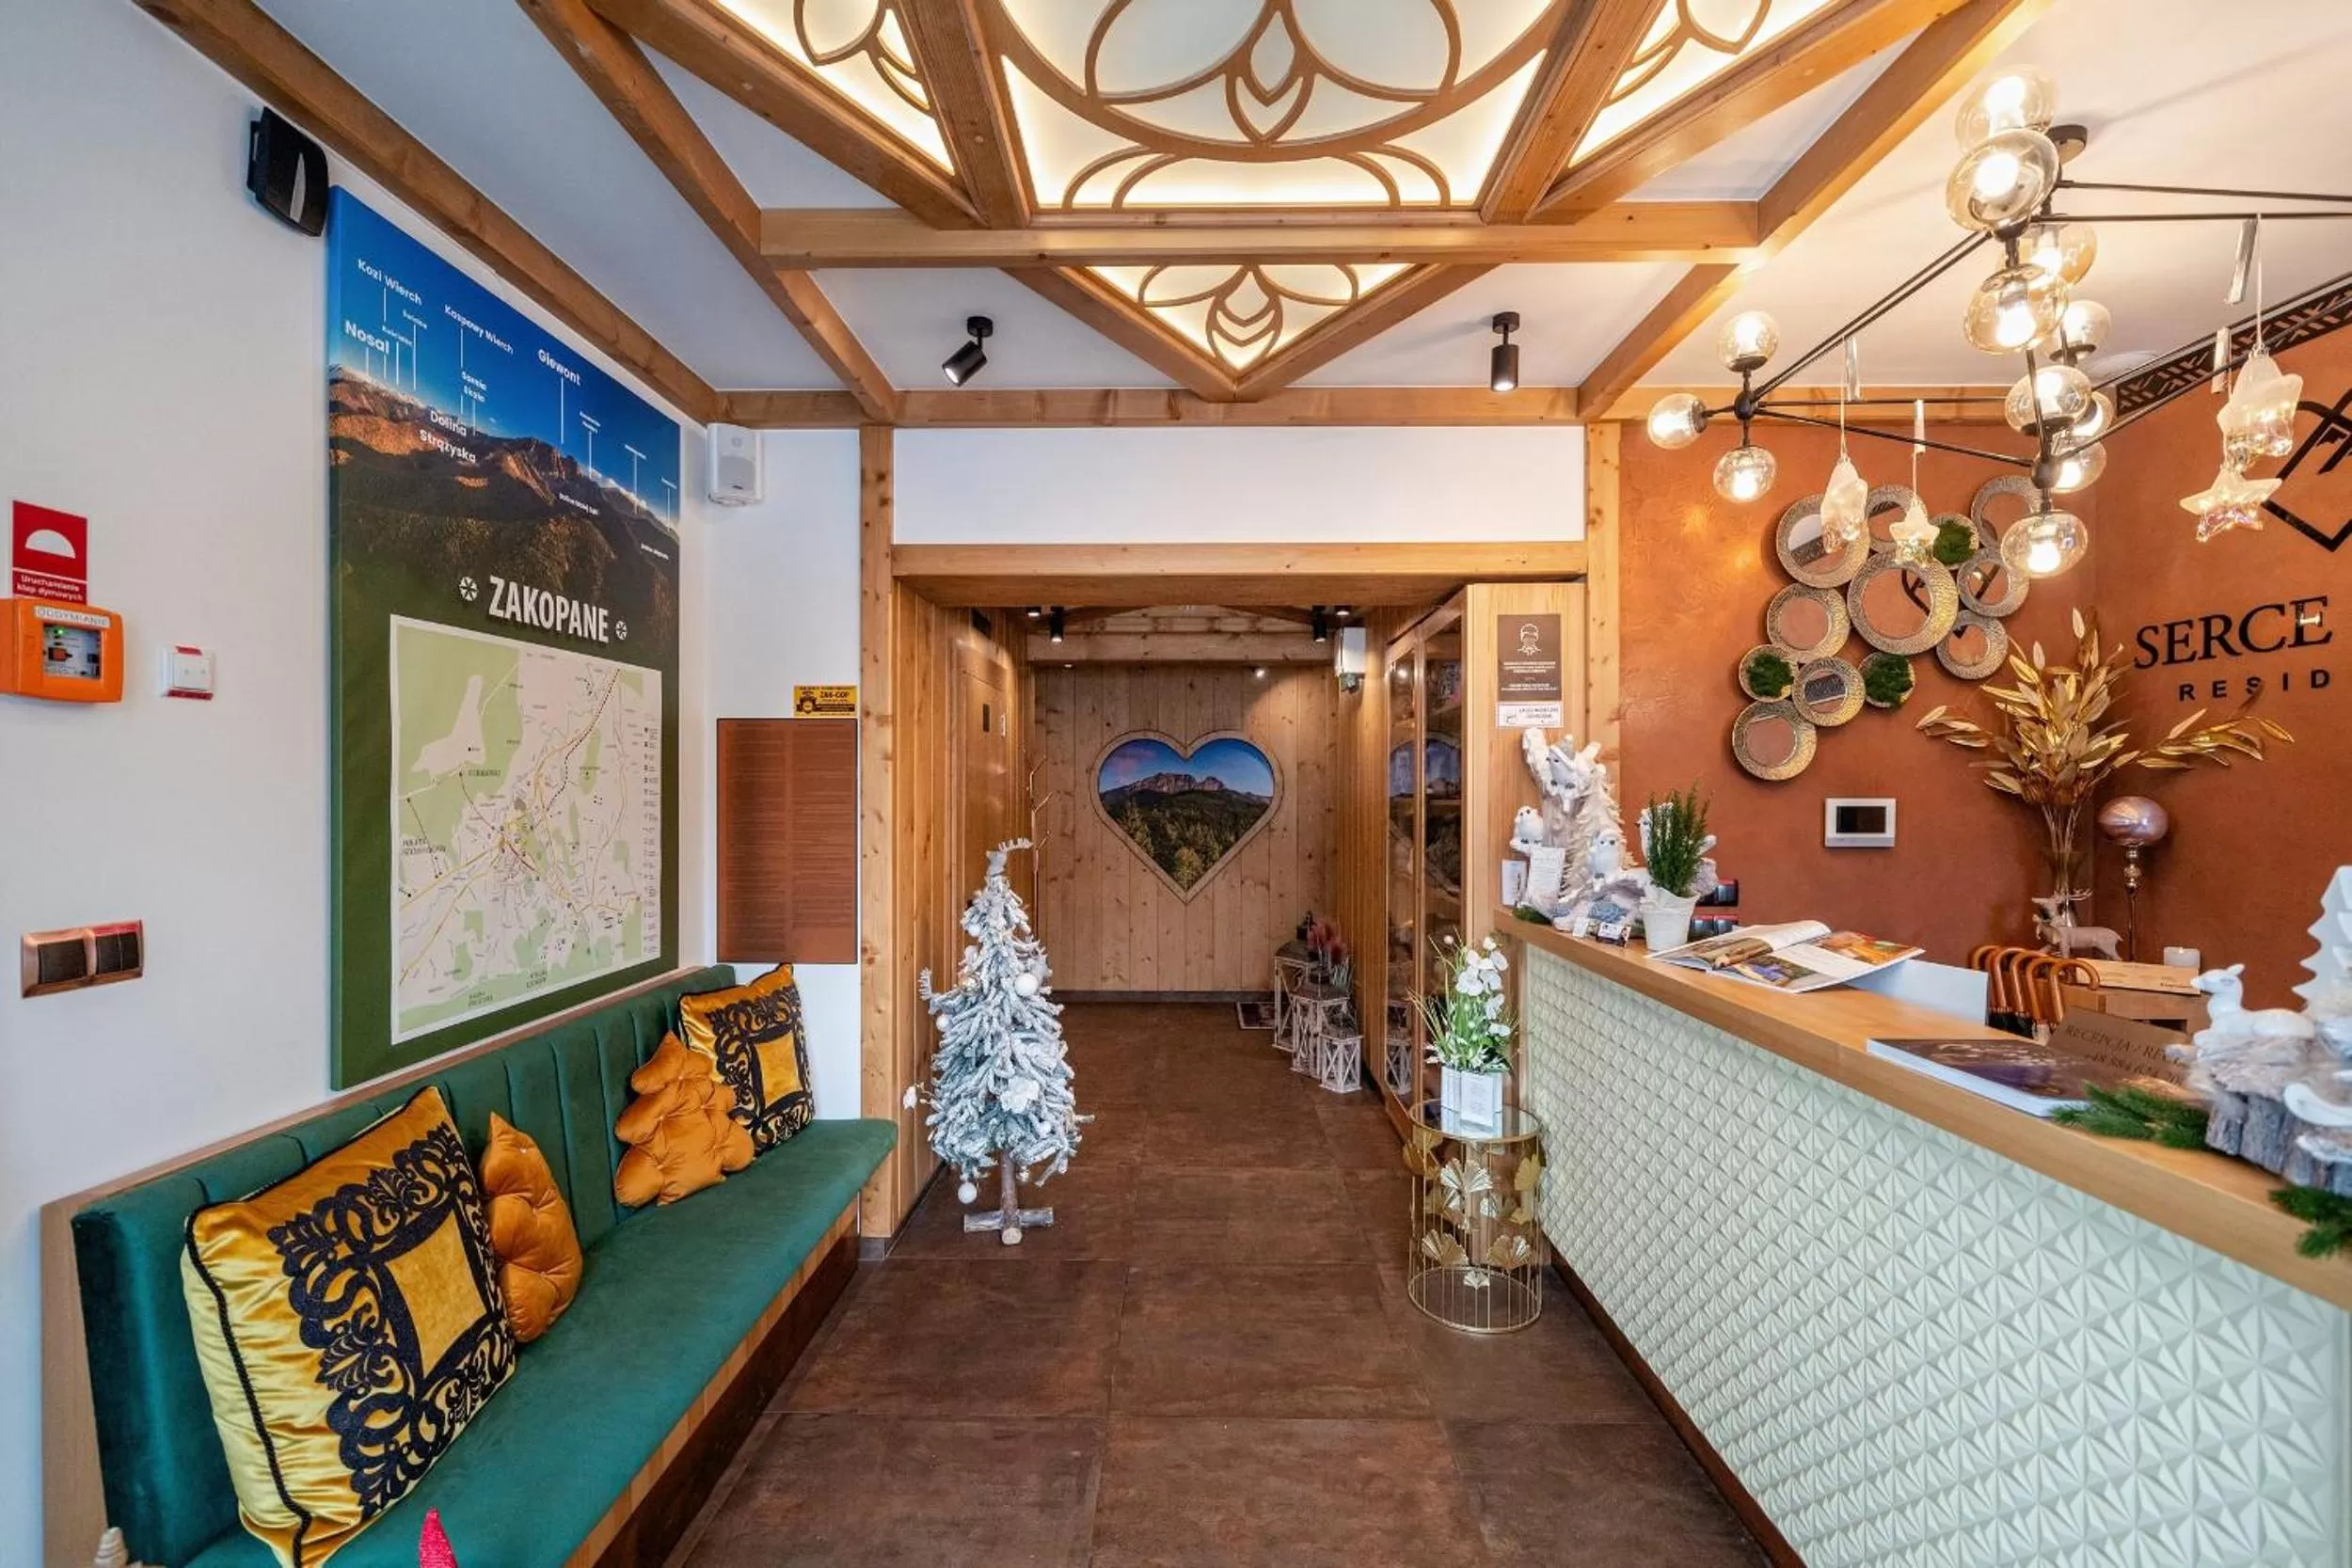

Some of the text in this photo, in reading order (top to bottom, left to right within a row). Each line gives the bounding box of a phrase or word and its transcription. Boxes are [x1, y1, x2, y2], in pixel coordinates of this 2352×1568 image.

[358, 259, 422, 306] Kozi Wierch
[345, 320, 389, 356] Nosal
[538, 348, 580, 387] Giewont
[430, 409, 467, 436] Dolina
[488, 575, 610, 643] ZAKOPANE
[2134, 595, 2332, 669] SERCE
[2178, 669, 2330, 701] RESID
[2066, 1024, 2131, 1053] RECEPCJA
